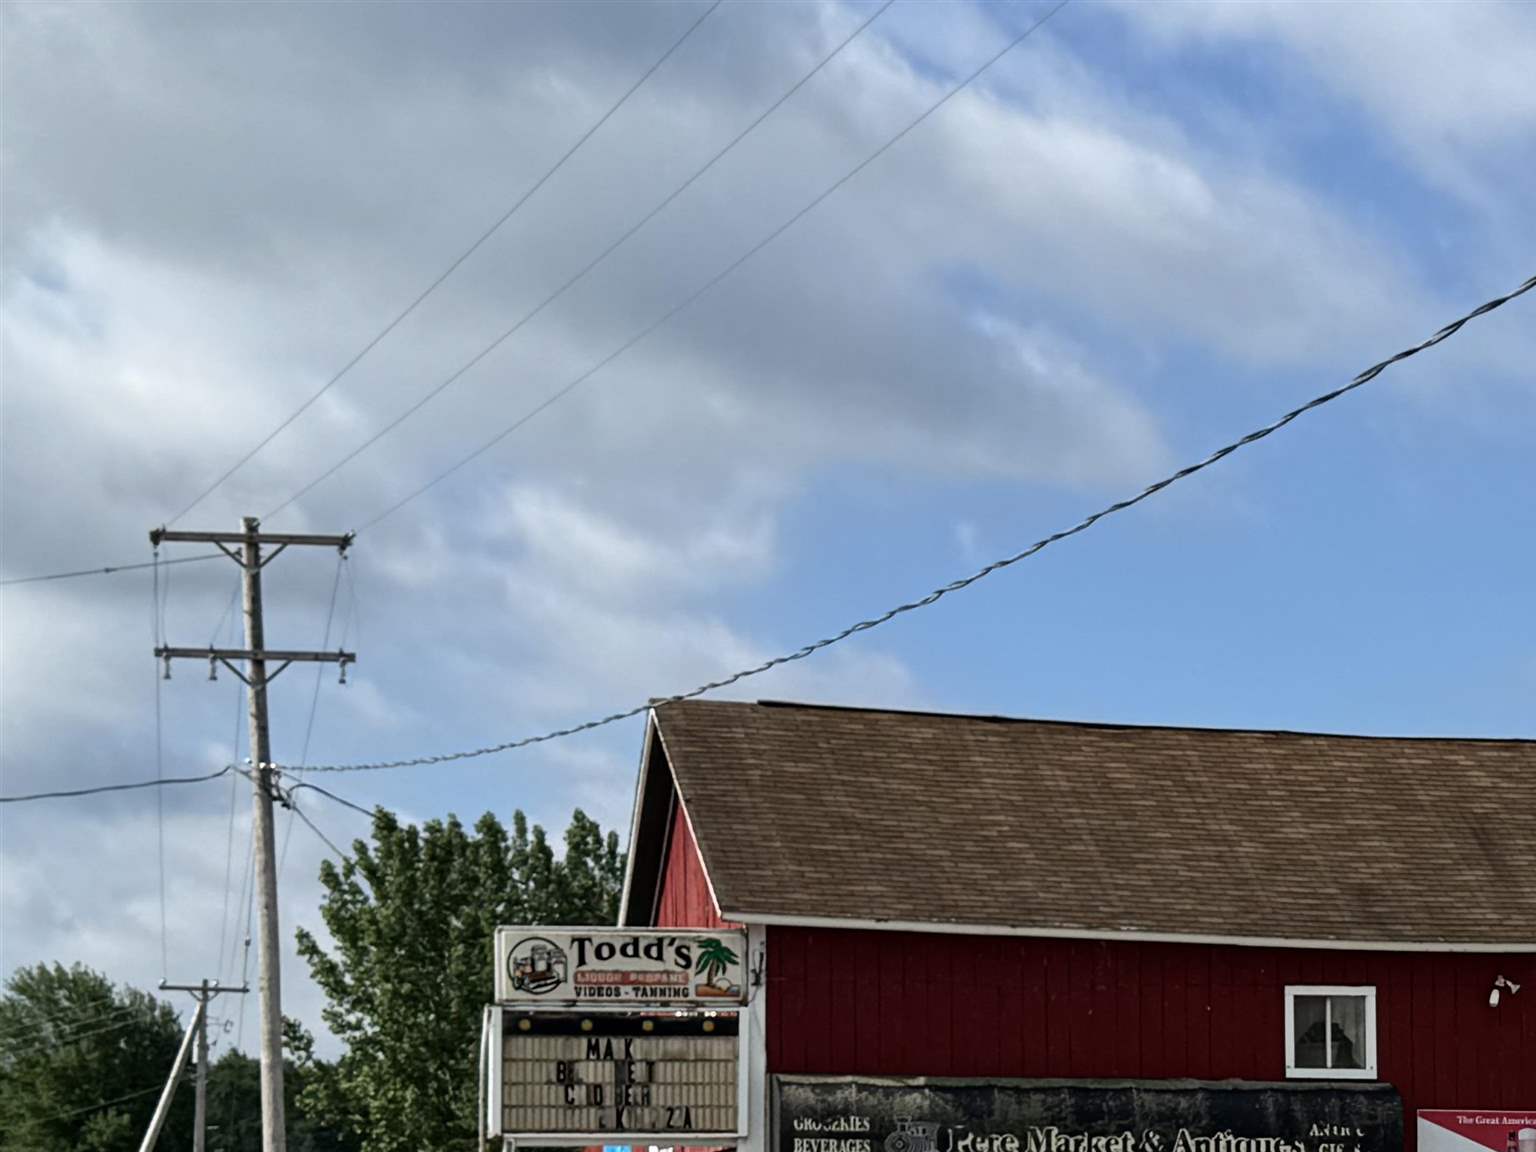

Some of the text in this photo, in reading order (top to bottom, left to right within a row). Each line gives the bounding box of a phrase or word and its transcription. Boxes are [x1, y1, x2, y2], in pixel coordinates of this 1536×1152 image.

[571, 937, 693, 969] Todd's
[575, 986, 621, 998] VIDEOS
[632, 986, 690, 998] TANNING
[1456, 1115, 1473, 1124] The
[1475, 1115, 1500, 1125] Great
